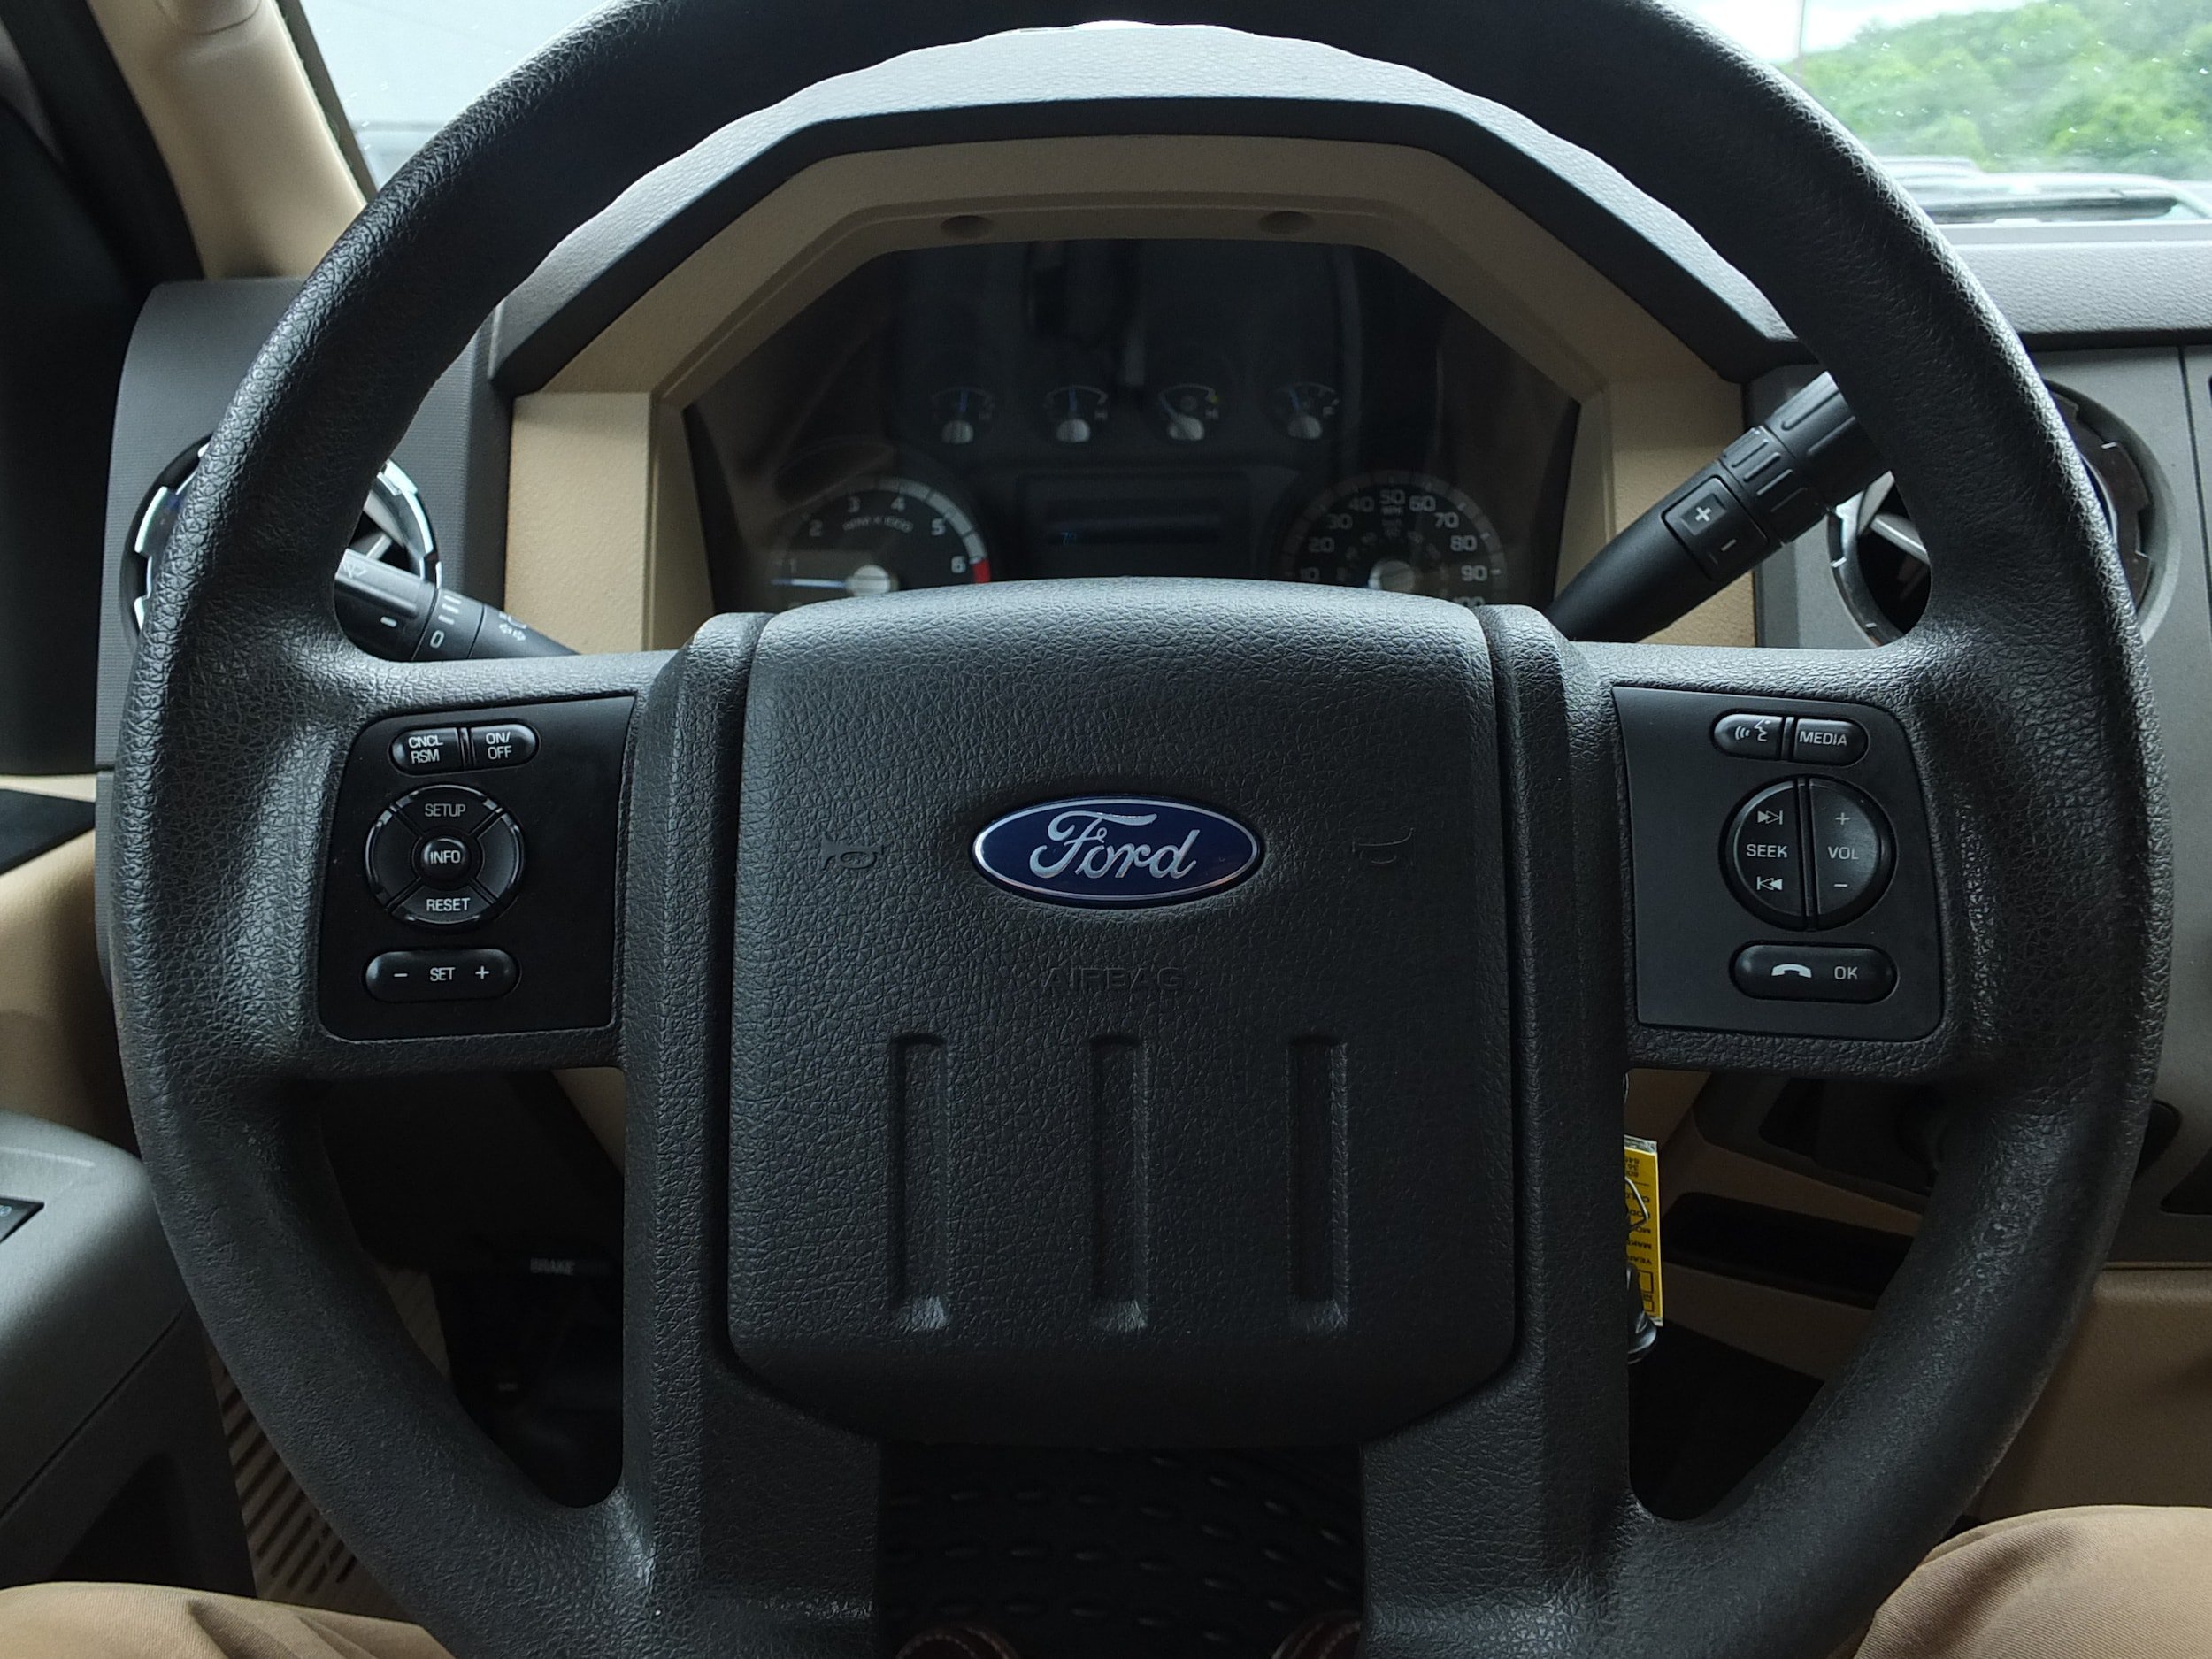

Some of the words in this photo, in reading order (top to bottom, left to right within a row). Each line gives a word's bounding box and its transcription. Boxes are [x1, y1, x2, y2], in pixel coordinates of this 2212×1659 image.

[847, 495, 861, 513] 3
[890, 495, 906, 513] 4
[1348, 495, 1375, 513] 40
[1379, 489, 1405, 505] 50
[1409, 495, 1437, 512] 60
[809, 519, 824, 538] 2
[931, 518, 946, 536] 5
[1326, 512, 1353, 531] 30
[1433, 511, 1460, 529] 70
[1309, 536, 1335, 554] 20
[1450, 534, 1477, 553] 80
[951, 556, 967, 574] 6
[1462, 565, 1487, 582] 90
[408, 734, 443, 749] CNCL
[486, 731, 511, 746] ON/
[1799, 730, 1848, 748] MEDIA
[411, 748, 441, 764] RSM
[487, 746, 512, 761] OFF
[424, 803, 466, 818] SETUP
[1026, 809, 1201, 880] Ford
[1746, 843, 1788, 859] SEEK
[1827, 846, 1860, 860] VOL
[429, 849, 462, 864] INFO
[426, 897, 472, 912] RESET
[429, 965, 457, 982] SET
[1041, 966, 1184, 991] AIRBAG
[1833, 965, 1859, 981] OK
